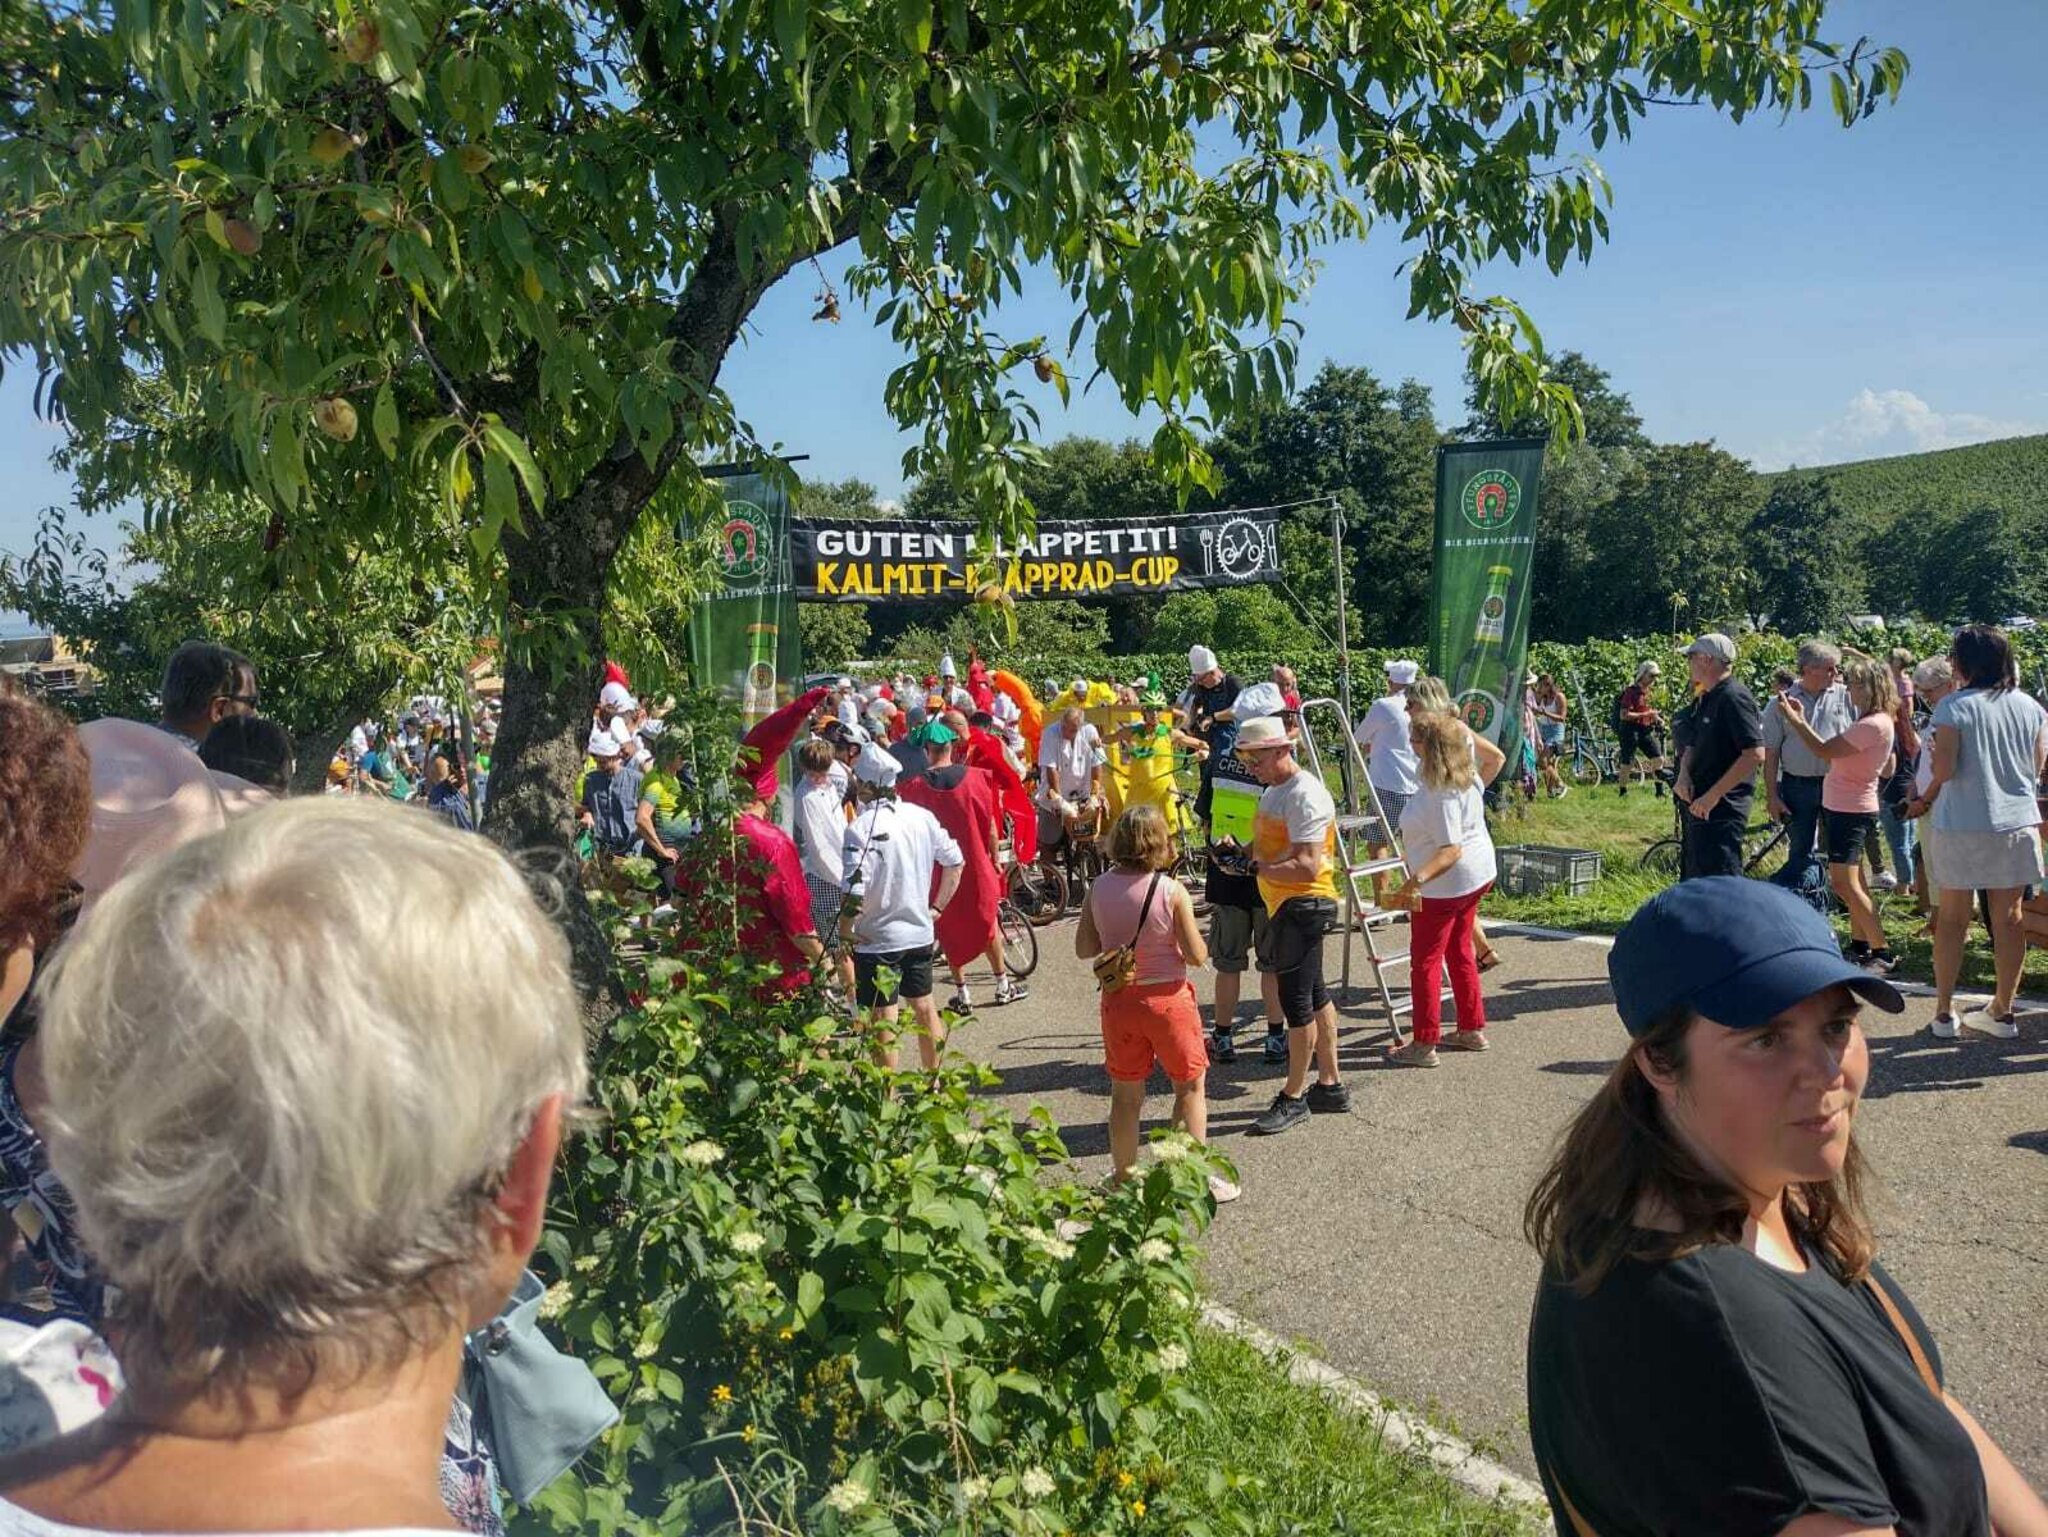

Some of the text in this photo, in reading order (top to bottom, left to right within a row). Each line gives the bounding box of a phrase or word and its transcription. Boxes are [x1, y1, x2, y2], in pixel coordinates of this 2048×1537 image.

[816, 529, 954, 558] GUTEN
[816, 556, 1179, 595] KALMIT-KAPPRAD-CUP
[1218, 757, 1253, 777] CRE
